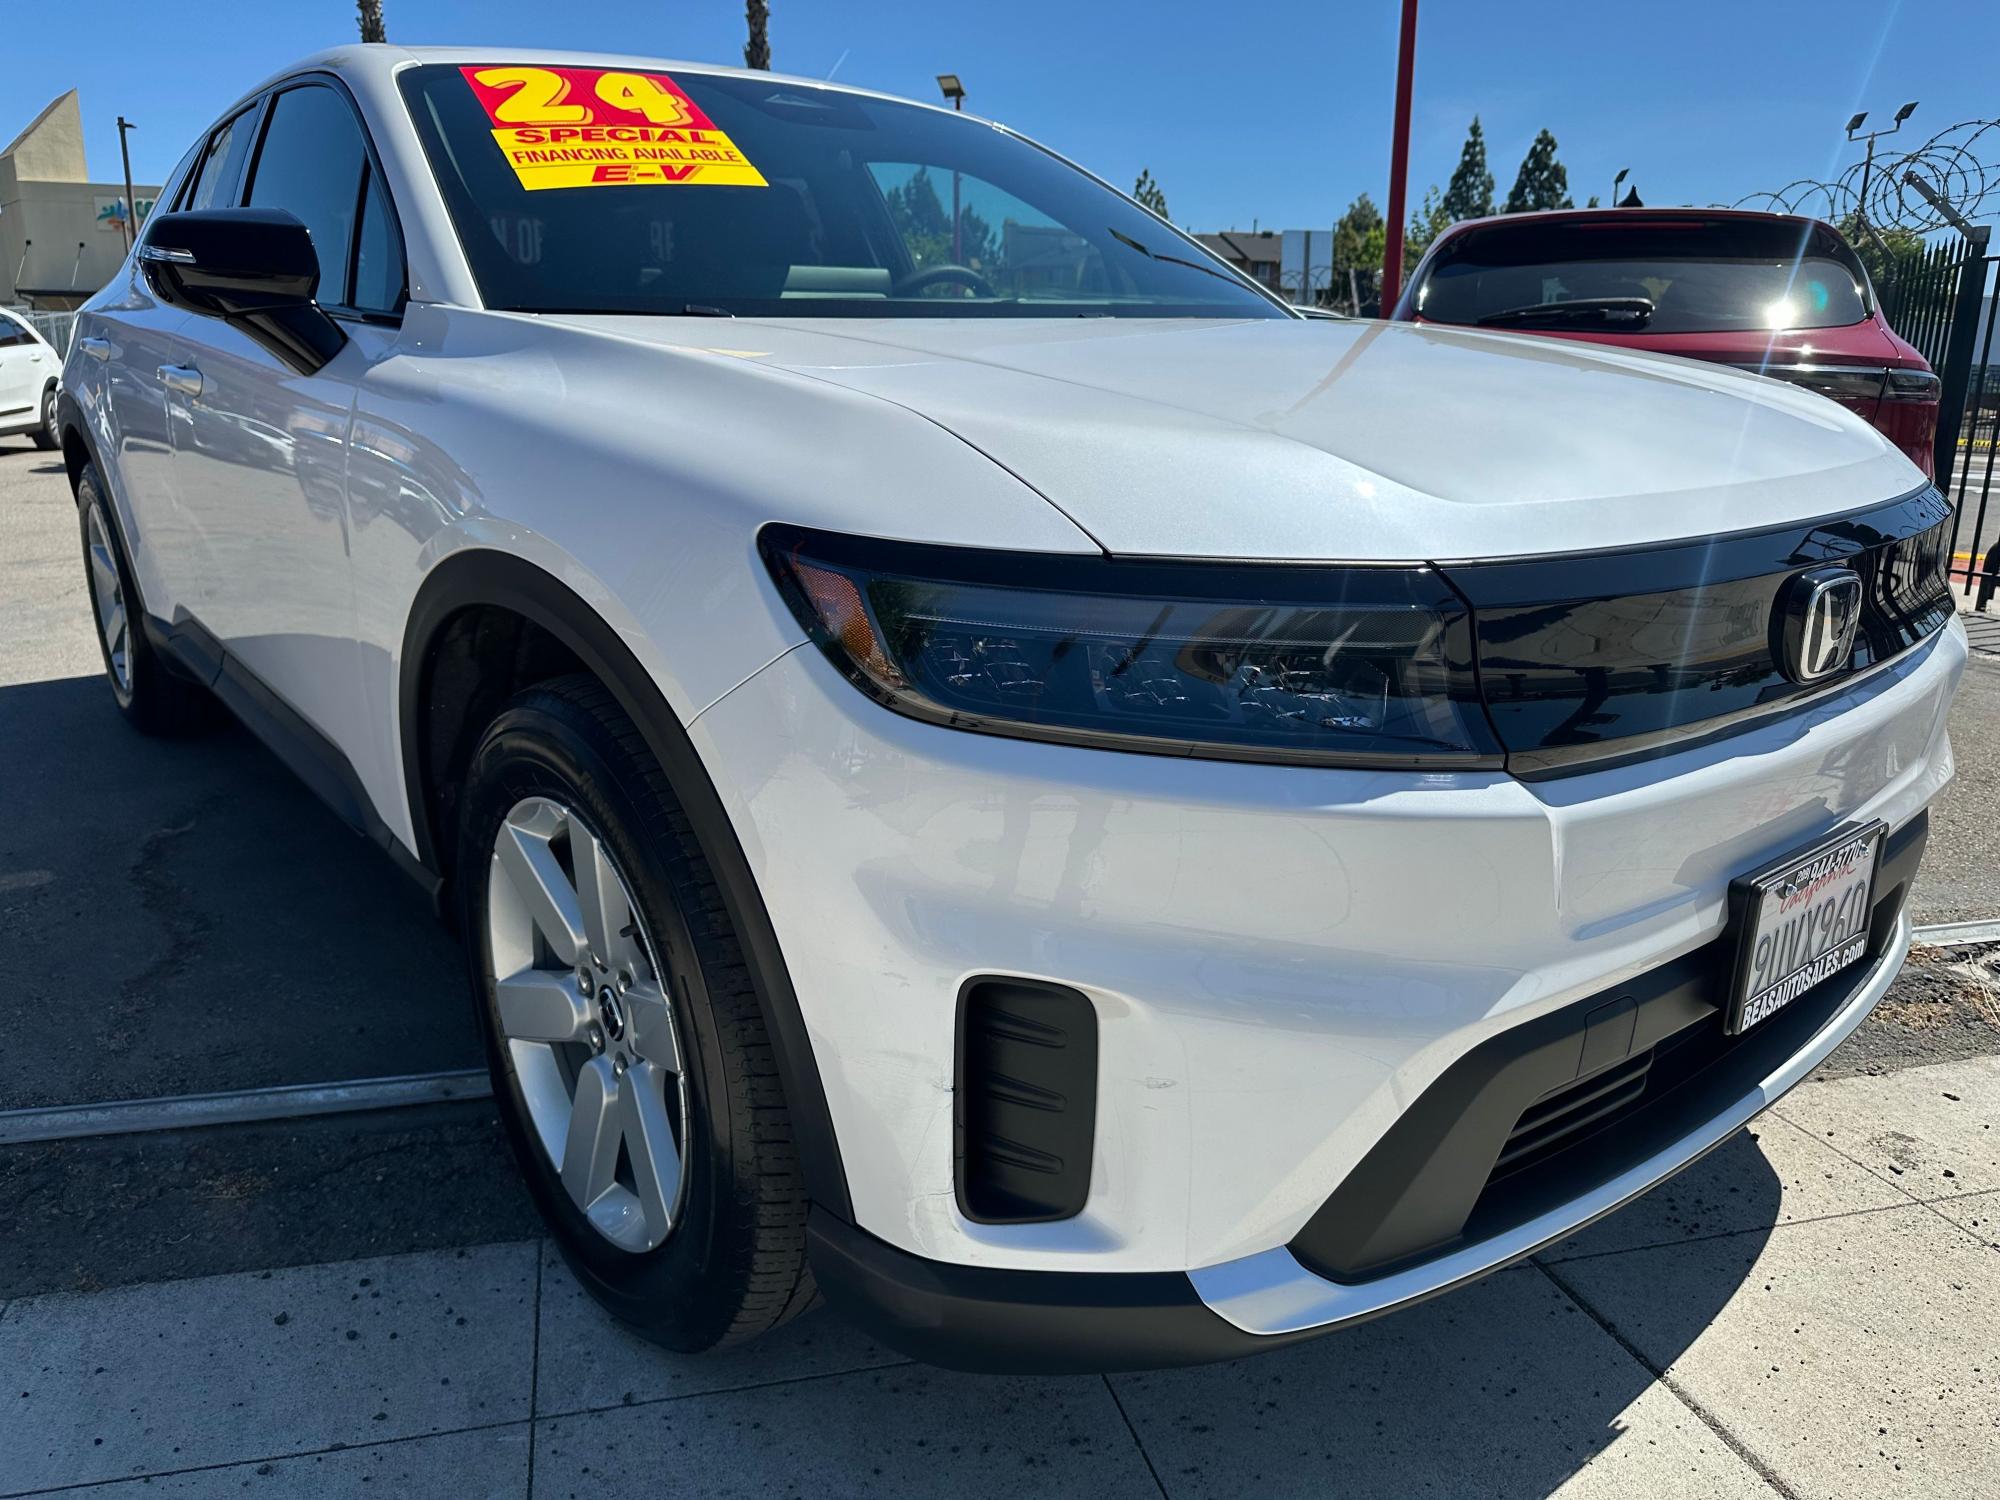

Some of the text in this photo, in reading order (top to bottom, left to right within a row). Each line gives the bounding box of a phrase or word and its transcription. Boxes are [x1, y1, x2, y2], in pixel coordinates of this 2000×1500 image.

[474, 67, 693, 126] 24
[514, 128, 721, 146] SPECIAL
[512, 147, 742, 165] FINANCING AVAILABLE
[591, 164, 705, 183] E-V
[1751, 879, 1868, 998] 9UVX960
